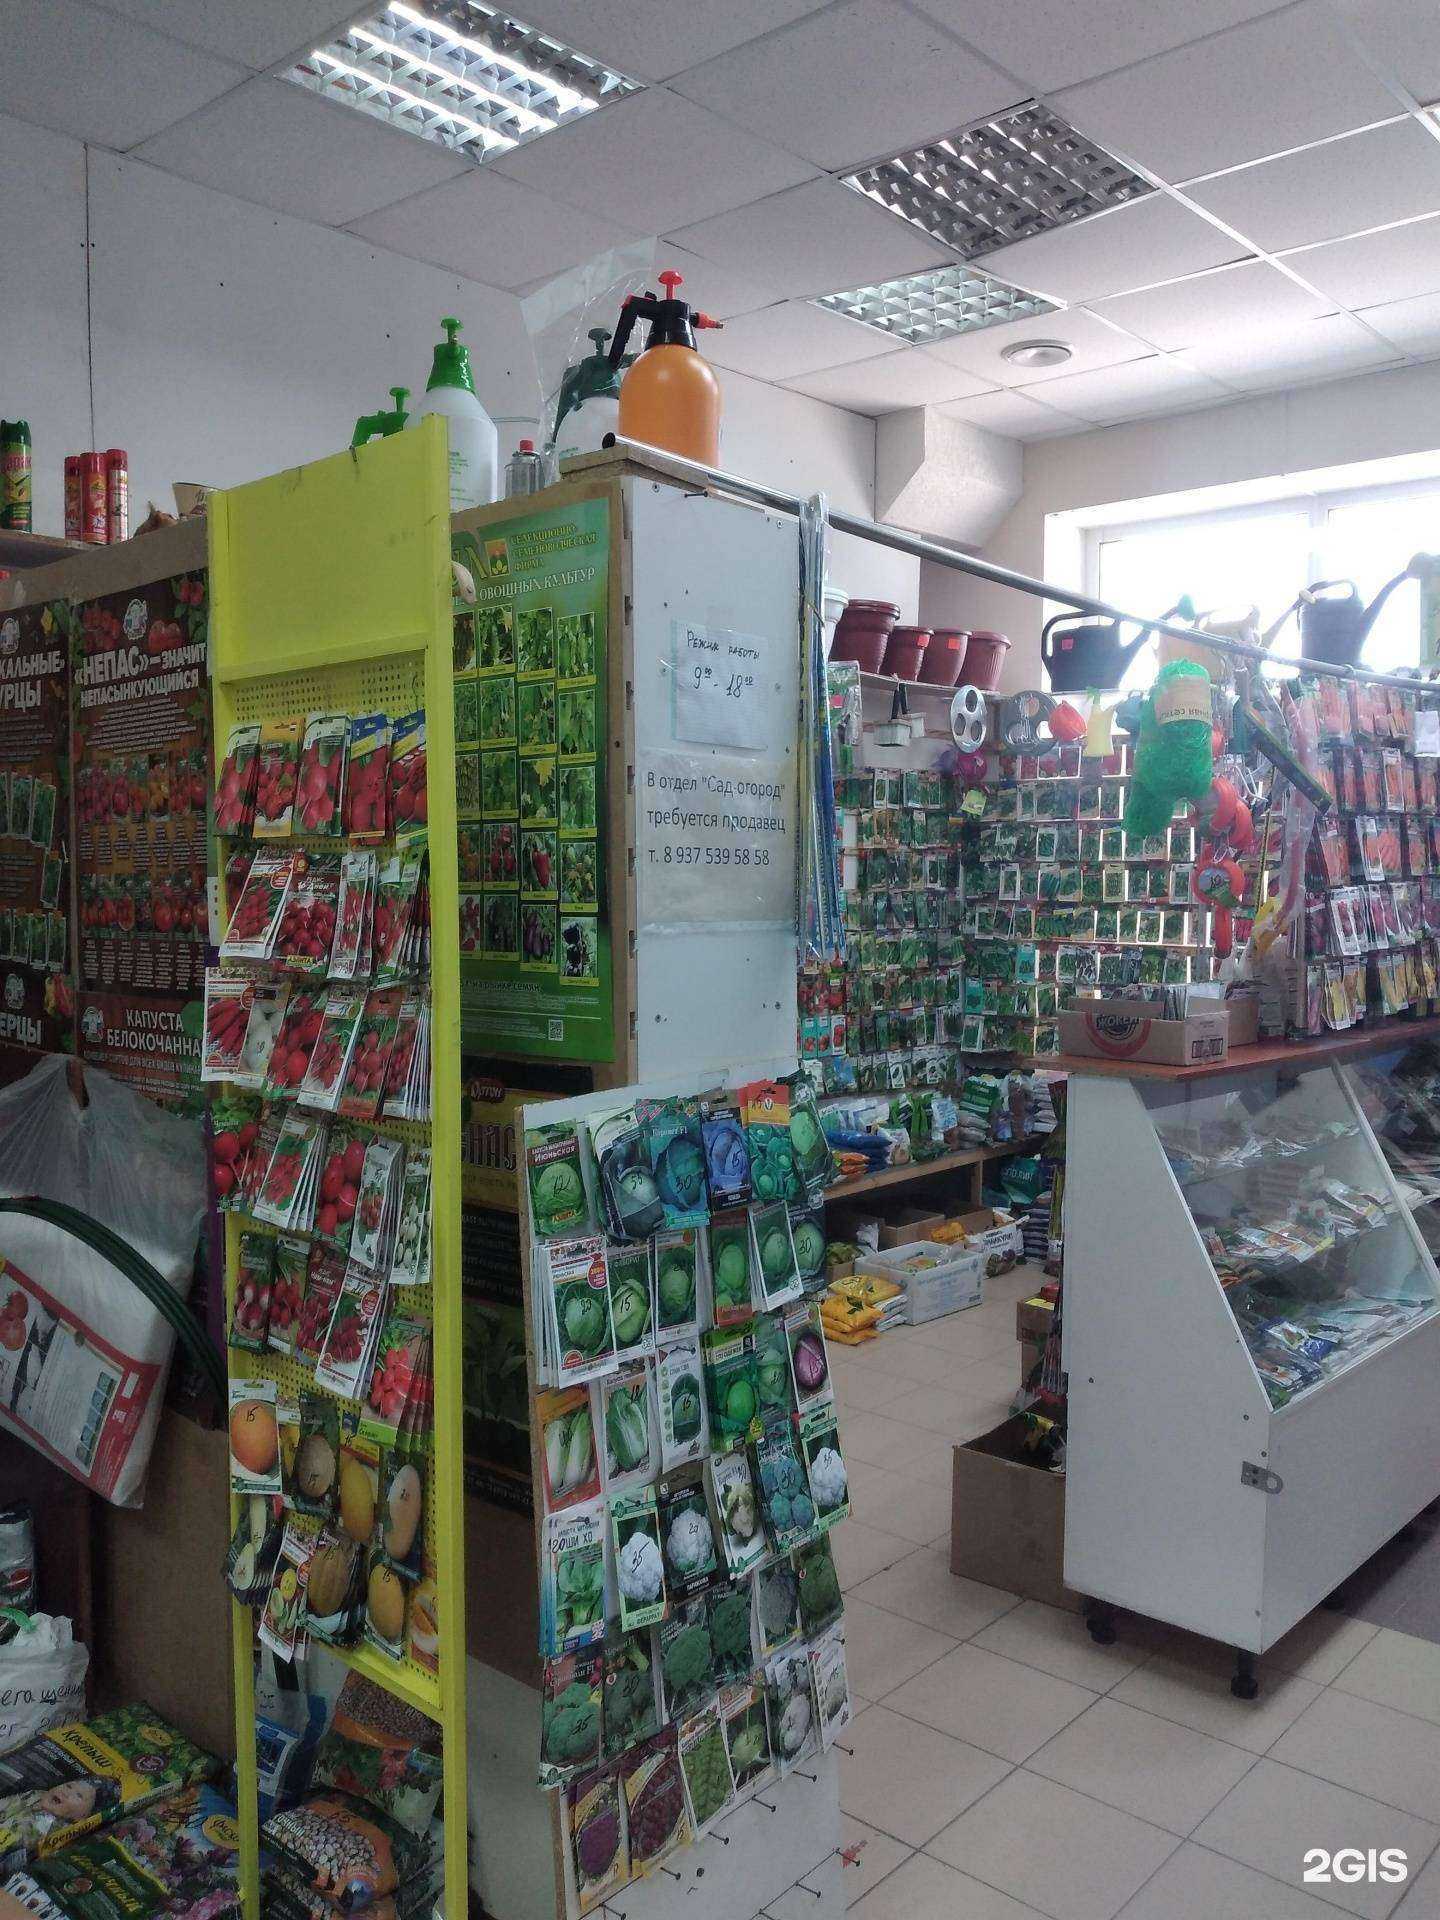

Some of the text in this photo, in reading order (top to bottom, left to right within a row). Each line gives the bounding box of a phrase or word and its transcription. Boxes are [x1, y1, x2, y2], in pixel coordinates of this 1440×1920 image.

[479, 566, 596, 602] ОВОЩНЫХ КУЛЬТУР
[162, 643, 206, 669] ЗНАЧИТ
[79, 668, 199, 708] НЕПАСЫНКУЮЩИЙСЯ
[647, 771, 655, 787] В
[659, 775, 697, 792] отдел
[647, 808, 786, 833] требуется продавец
[648, 846, 770, 866] т. 8 937 539 58 58
[126, 1008, 185, 1032] КАПУСТА
[106, 1028, 202, 1058] БЕЛОКОЧАННА
[533, 1145, 575, 1162] Июньская
[798, 1236, 812, 1255] 30
[621, 1292, 633, 1313] 15
[246, 1405, 262, 1422] 15
[62, 1729, 112, 1769] Крепыш
